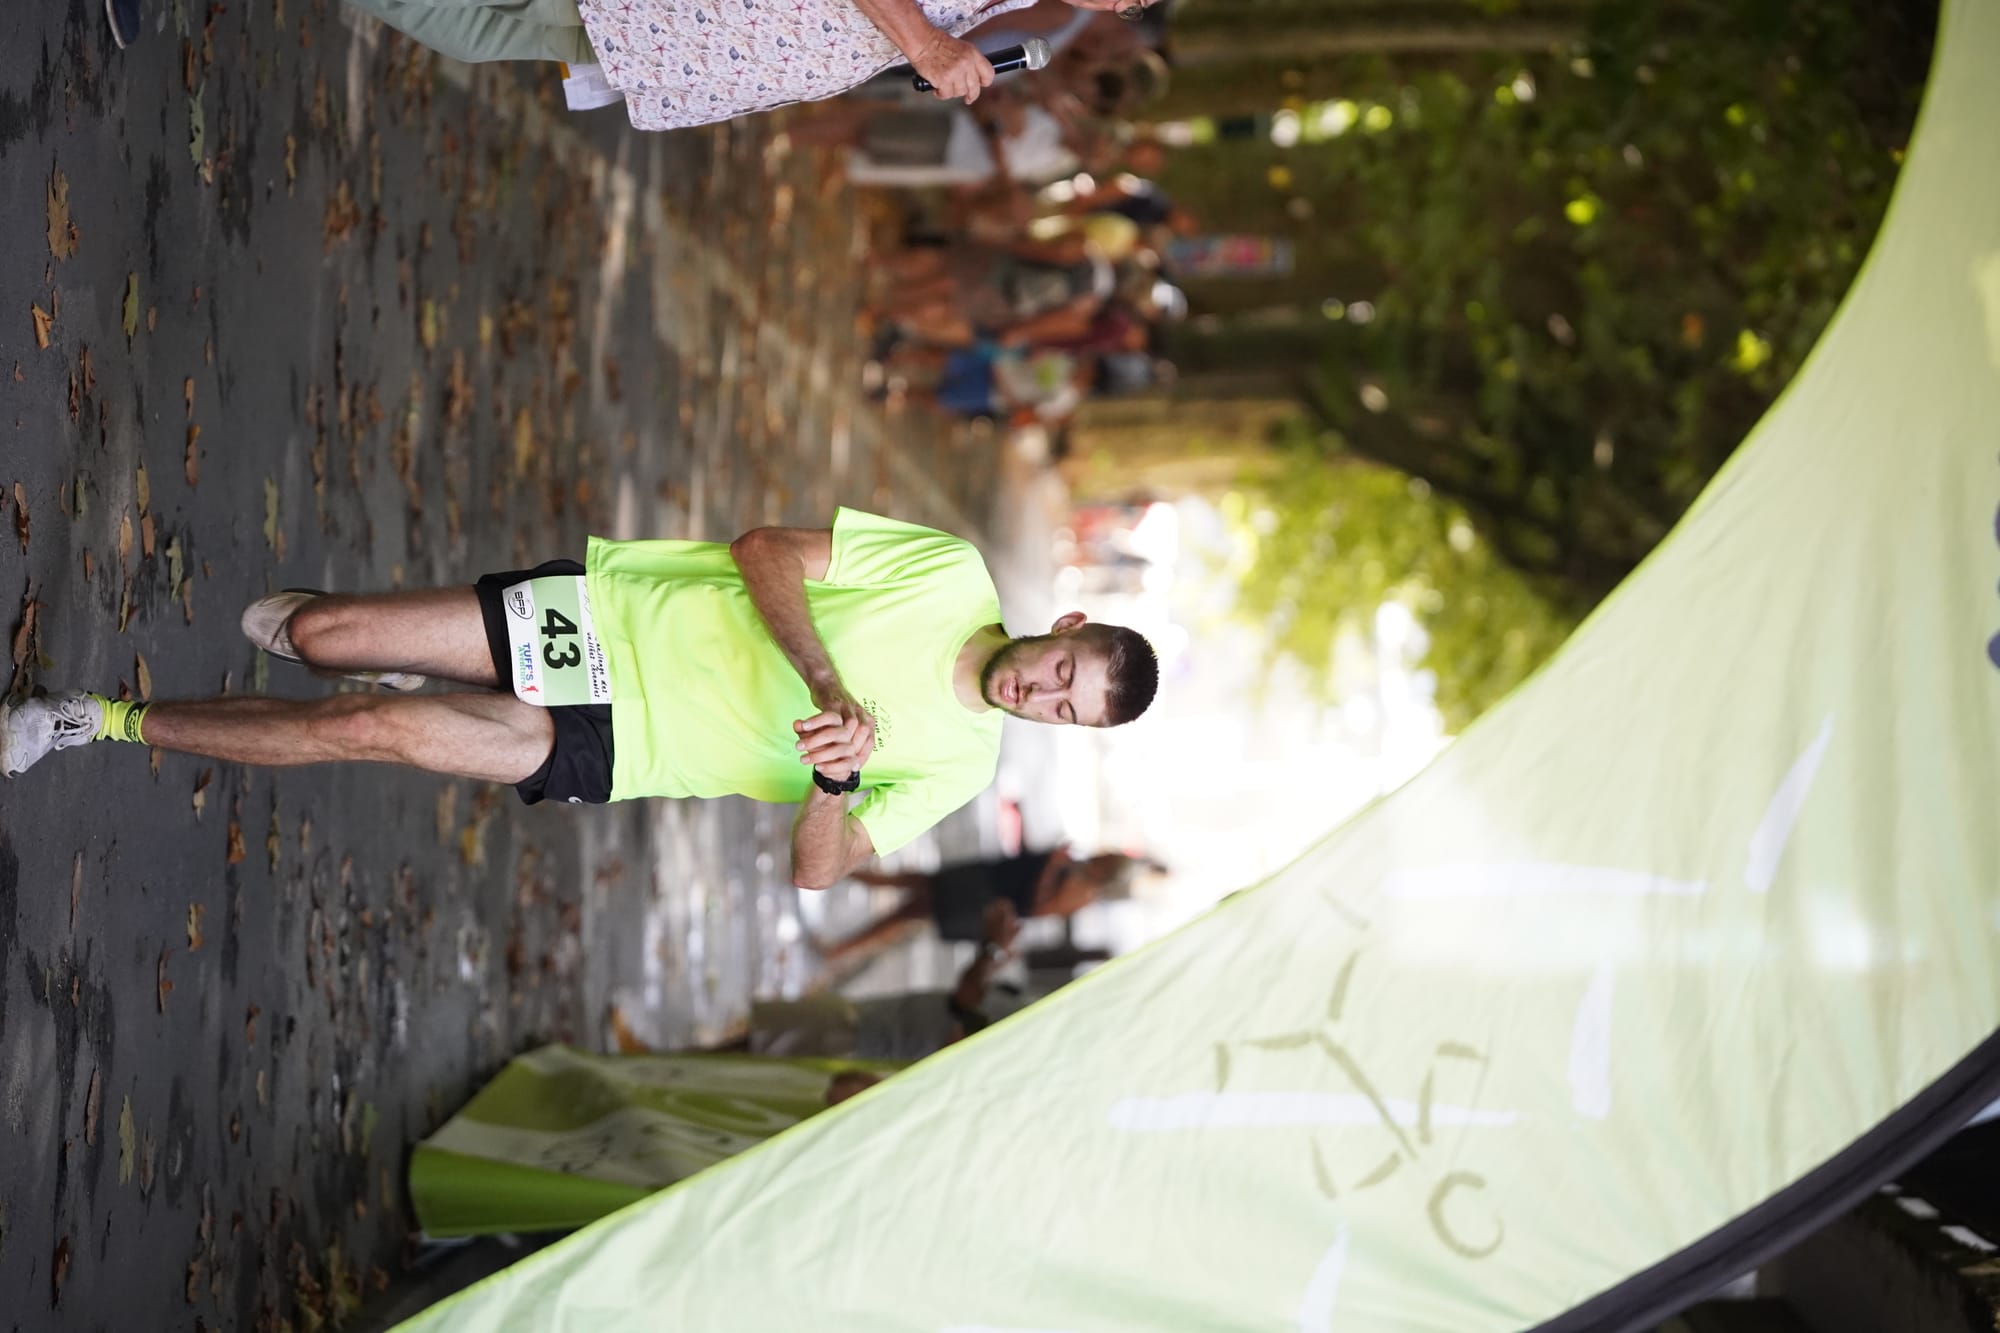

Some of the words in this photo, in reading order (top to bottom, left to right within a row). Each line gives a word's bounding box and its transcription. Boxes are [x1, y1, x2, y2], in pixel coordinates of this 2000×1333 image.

[515, 591, 525, 615] BFP
[523, 643, 534, 681] TUFF'S
[541, 609, 581, 669] 43
[595, 637, 605, 676] hallenge
[600, 680, 608, 693] des
